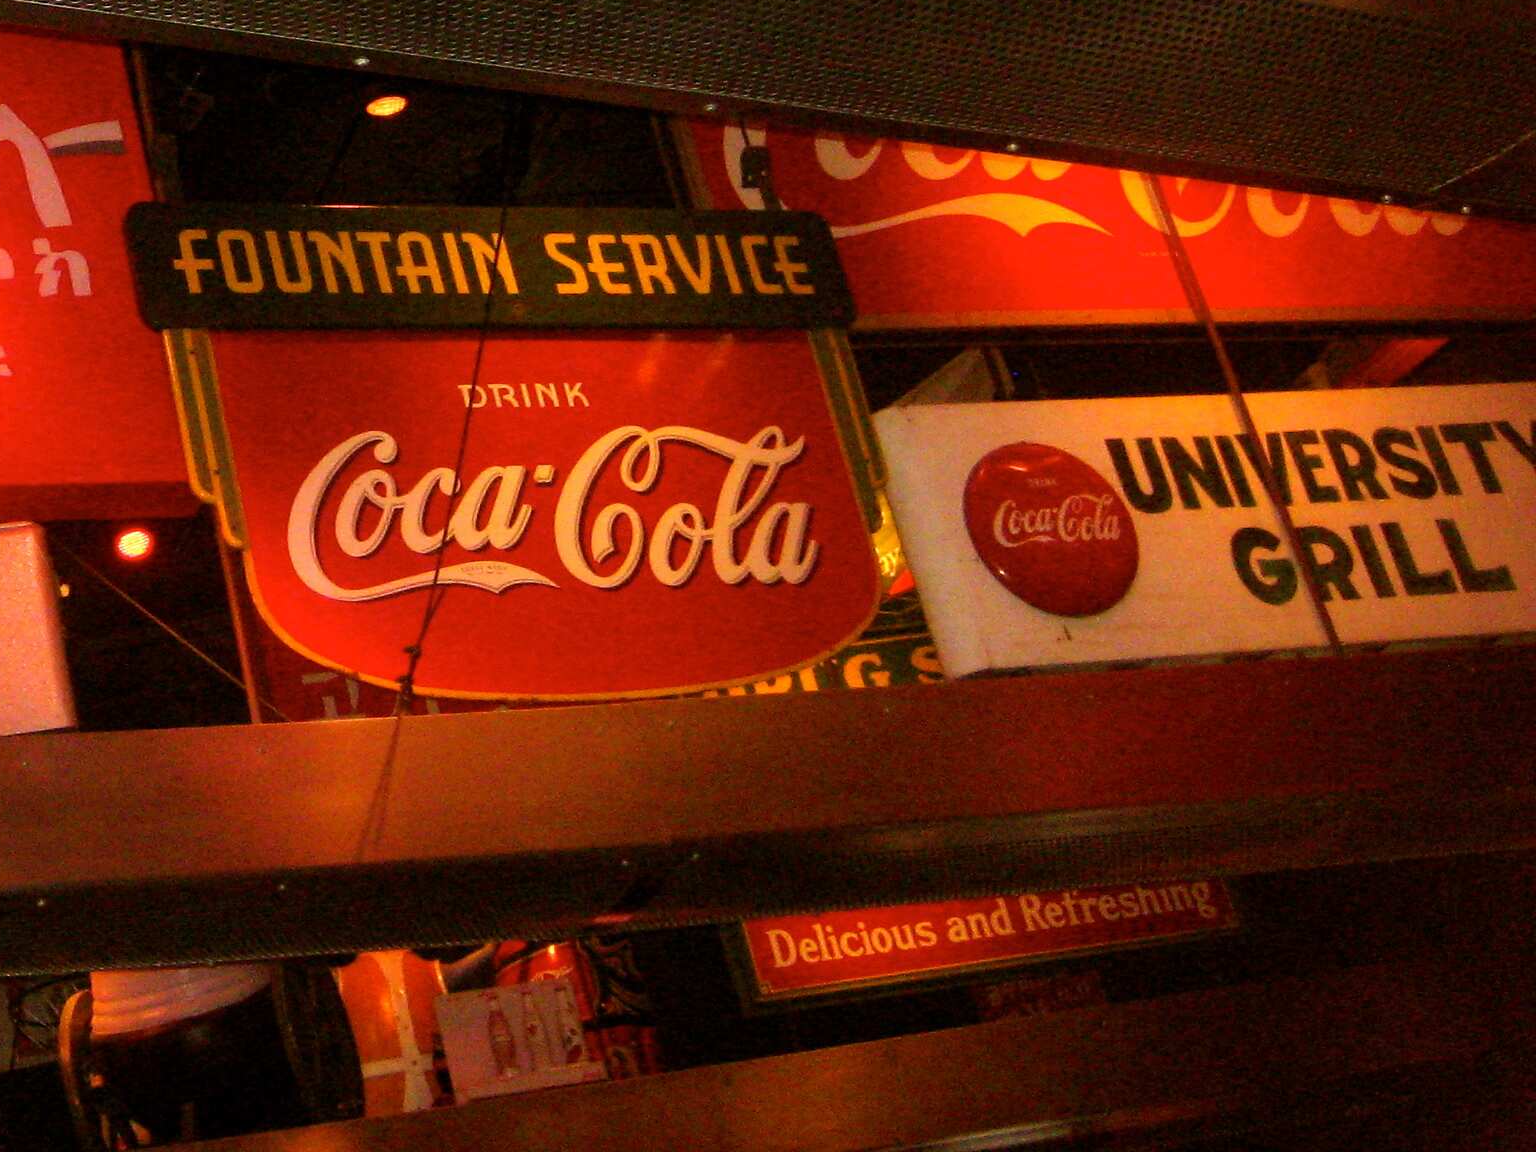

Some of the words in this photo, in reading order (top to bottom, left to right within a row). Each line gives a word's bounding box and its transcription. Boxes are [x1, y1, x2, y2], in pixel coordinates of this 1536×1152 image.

[173, 228, 519, 296] FOUNTAIN
[544, 232, 815, 296] SERVICE
[458, 382, 590, 409] DRINK
[287, 425, 819, 602] Coca-Cola
[993, 494, 1121, 548] Coca-Cola
[1230, 519, 1517, 606] GRILL
[767, 924, 938, 969] Delicious
[947, 897, 1016, 944] and
[1020, 881, 1213, 933] Refreshing
